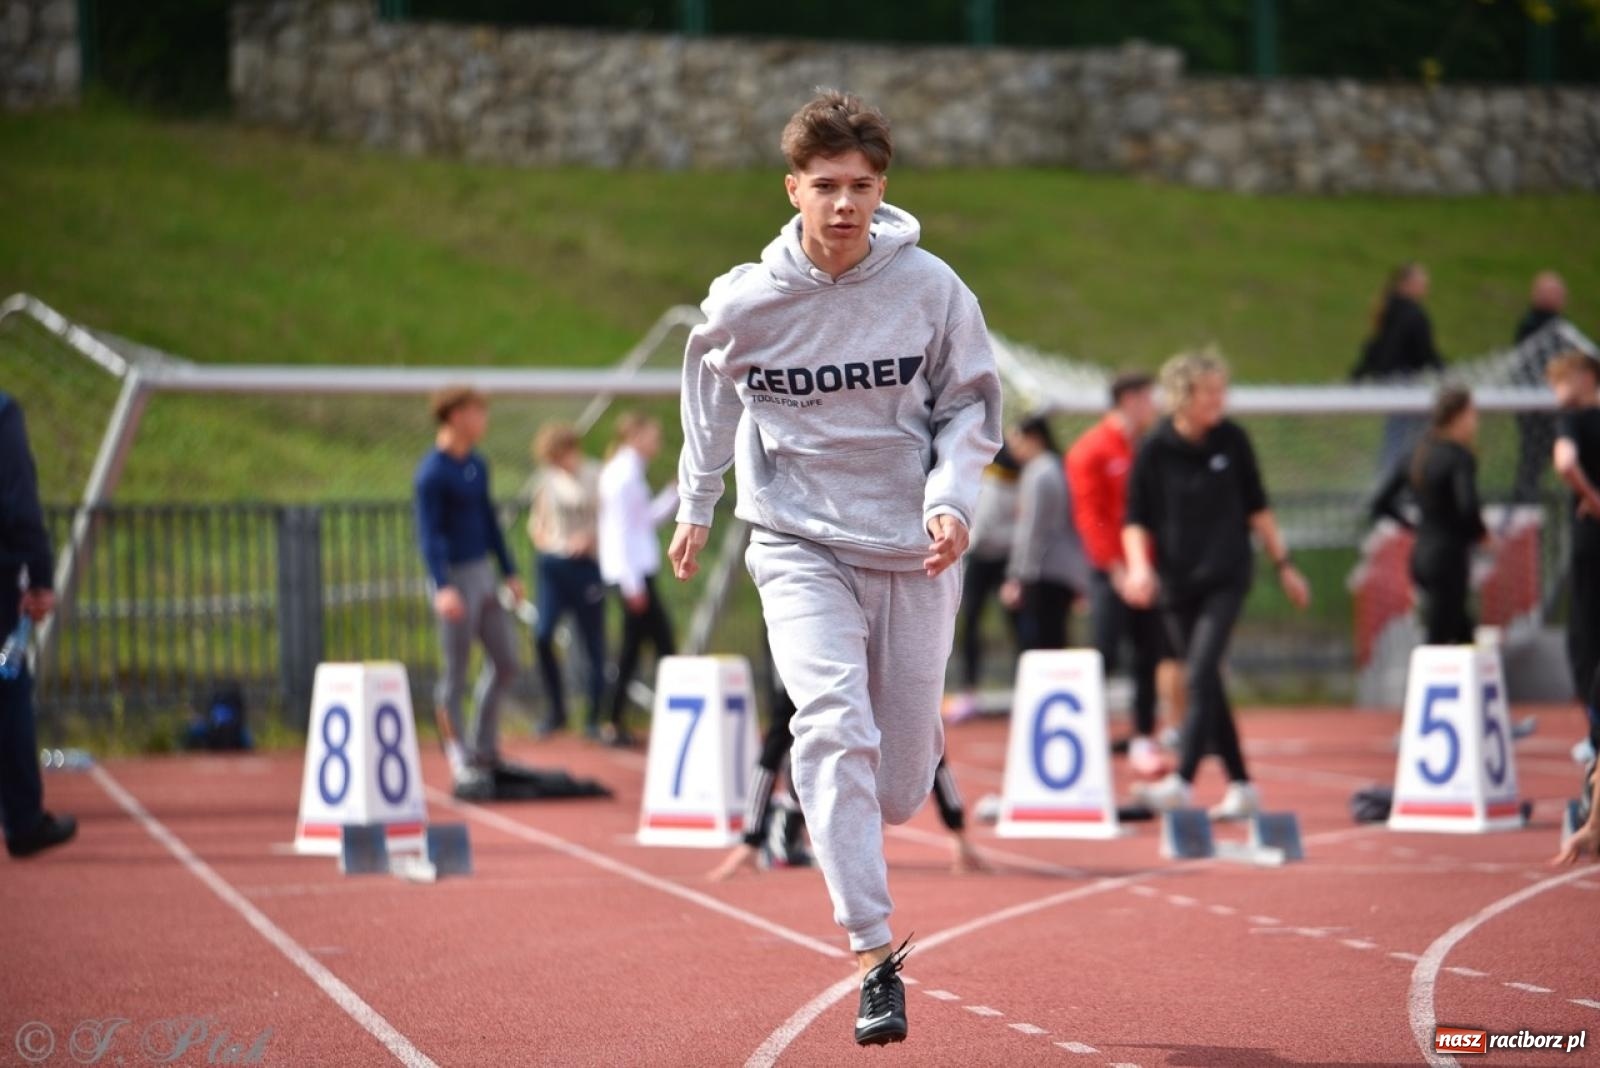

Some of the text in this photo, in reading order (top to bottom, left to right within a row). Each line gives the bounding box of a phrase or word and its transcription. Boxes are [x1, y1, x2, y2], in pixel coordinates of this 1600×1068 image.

[747, 358, 897, 396] GEDORE
[752, 394, 824, 408] TOOLS FOR LIFE
[319, 703, 351, 806] 8
[375, 702, 408, 805] 8
[666, 696, 705, 798] 7
[725, 695, 746, 799] 7
[1031, 690, 1085, 791] 6
[1415, 685, 1460, 785] 5
[1482, 684, 1506, 787] 5
